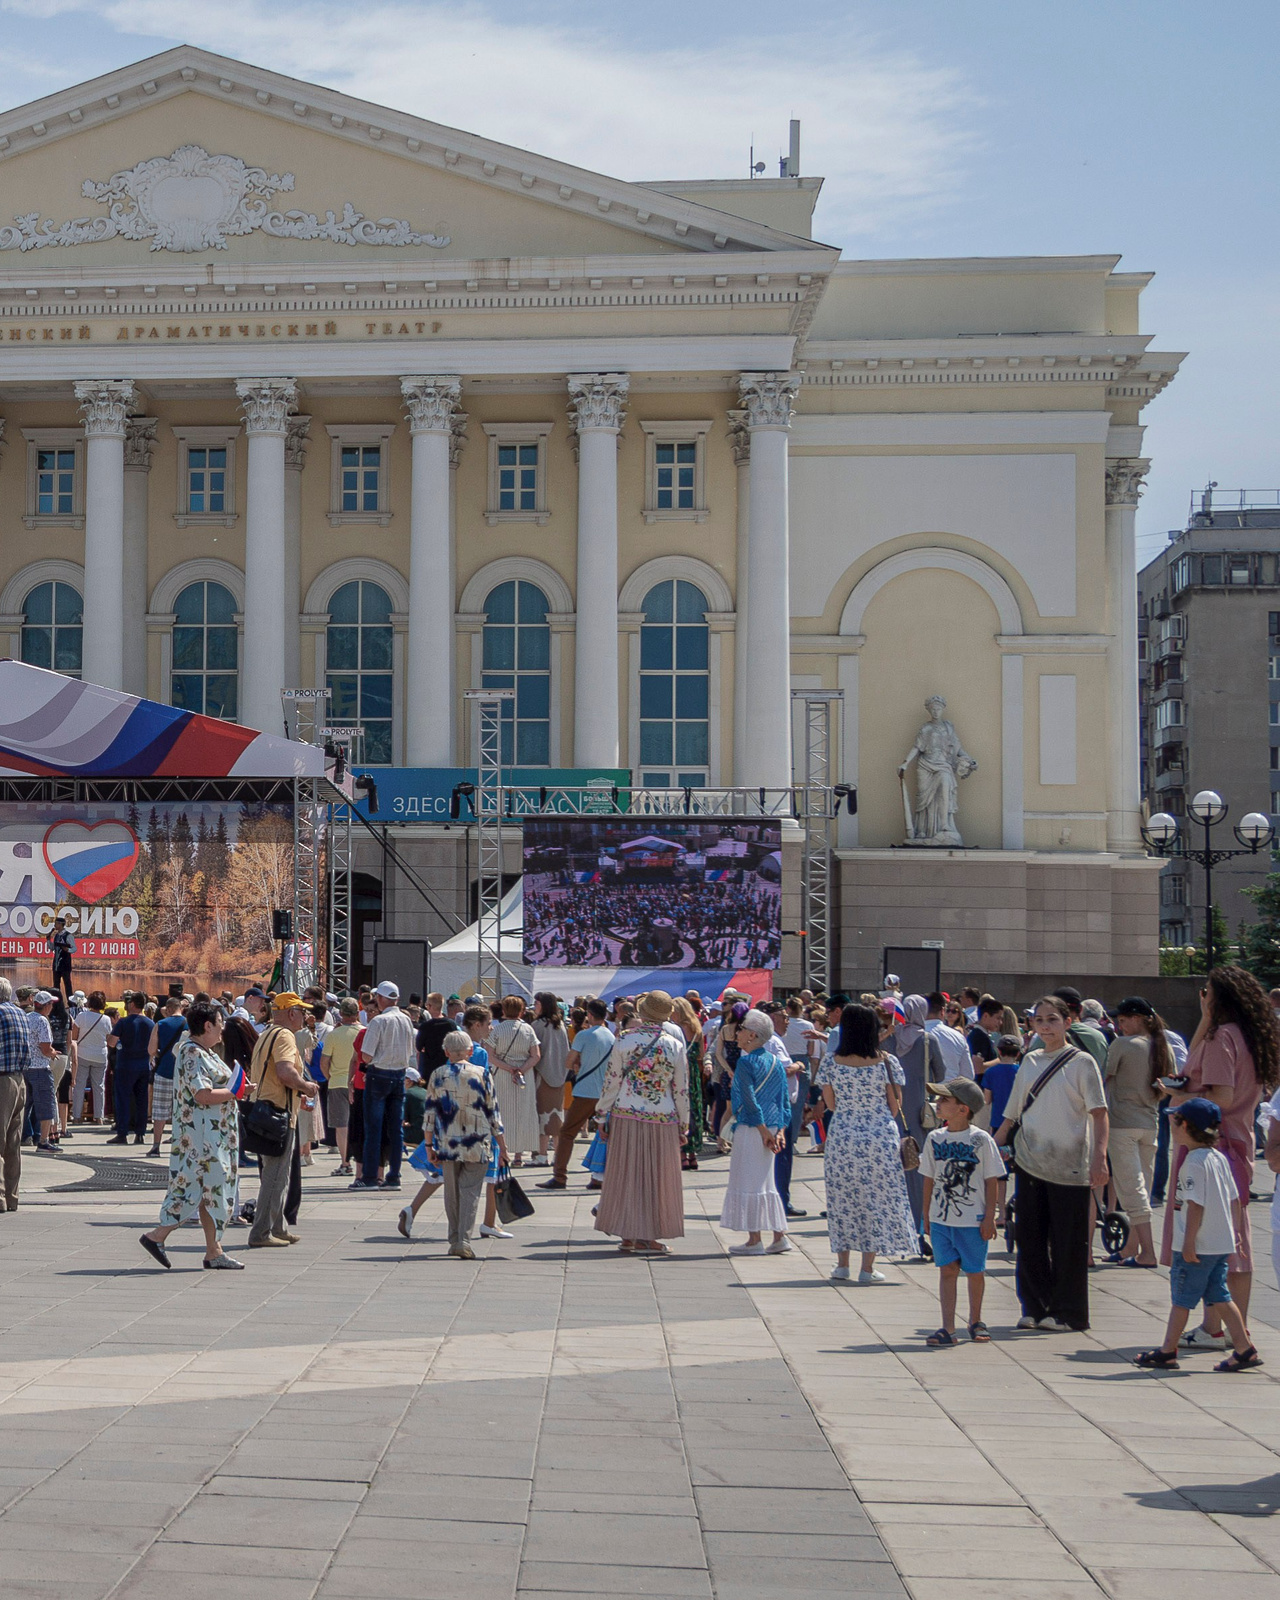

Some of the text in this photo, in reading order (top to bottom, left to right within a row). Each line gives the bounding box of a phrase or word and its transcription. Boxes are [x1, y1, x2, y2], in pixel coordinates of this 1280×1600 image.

[117, 321, 338, 340] ДРАМАТИЧЕСКИЙ
[366, 321, 443, 335] ТЕАТР
[294, 689, 327, 697] PROLYTE
[393, 796, 452, 816] ЗДЕС
[82, 942, 95, 955] 12
[101, 942, 136, 955] ИЮНЯ
